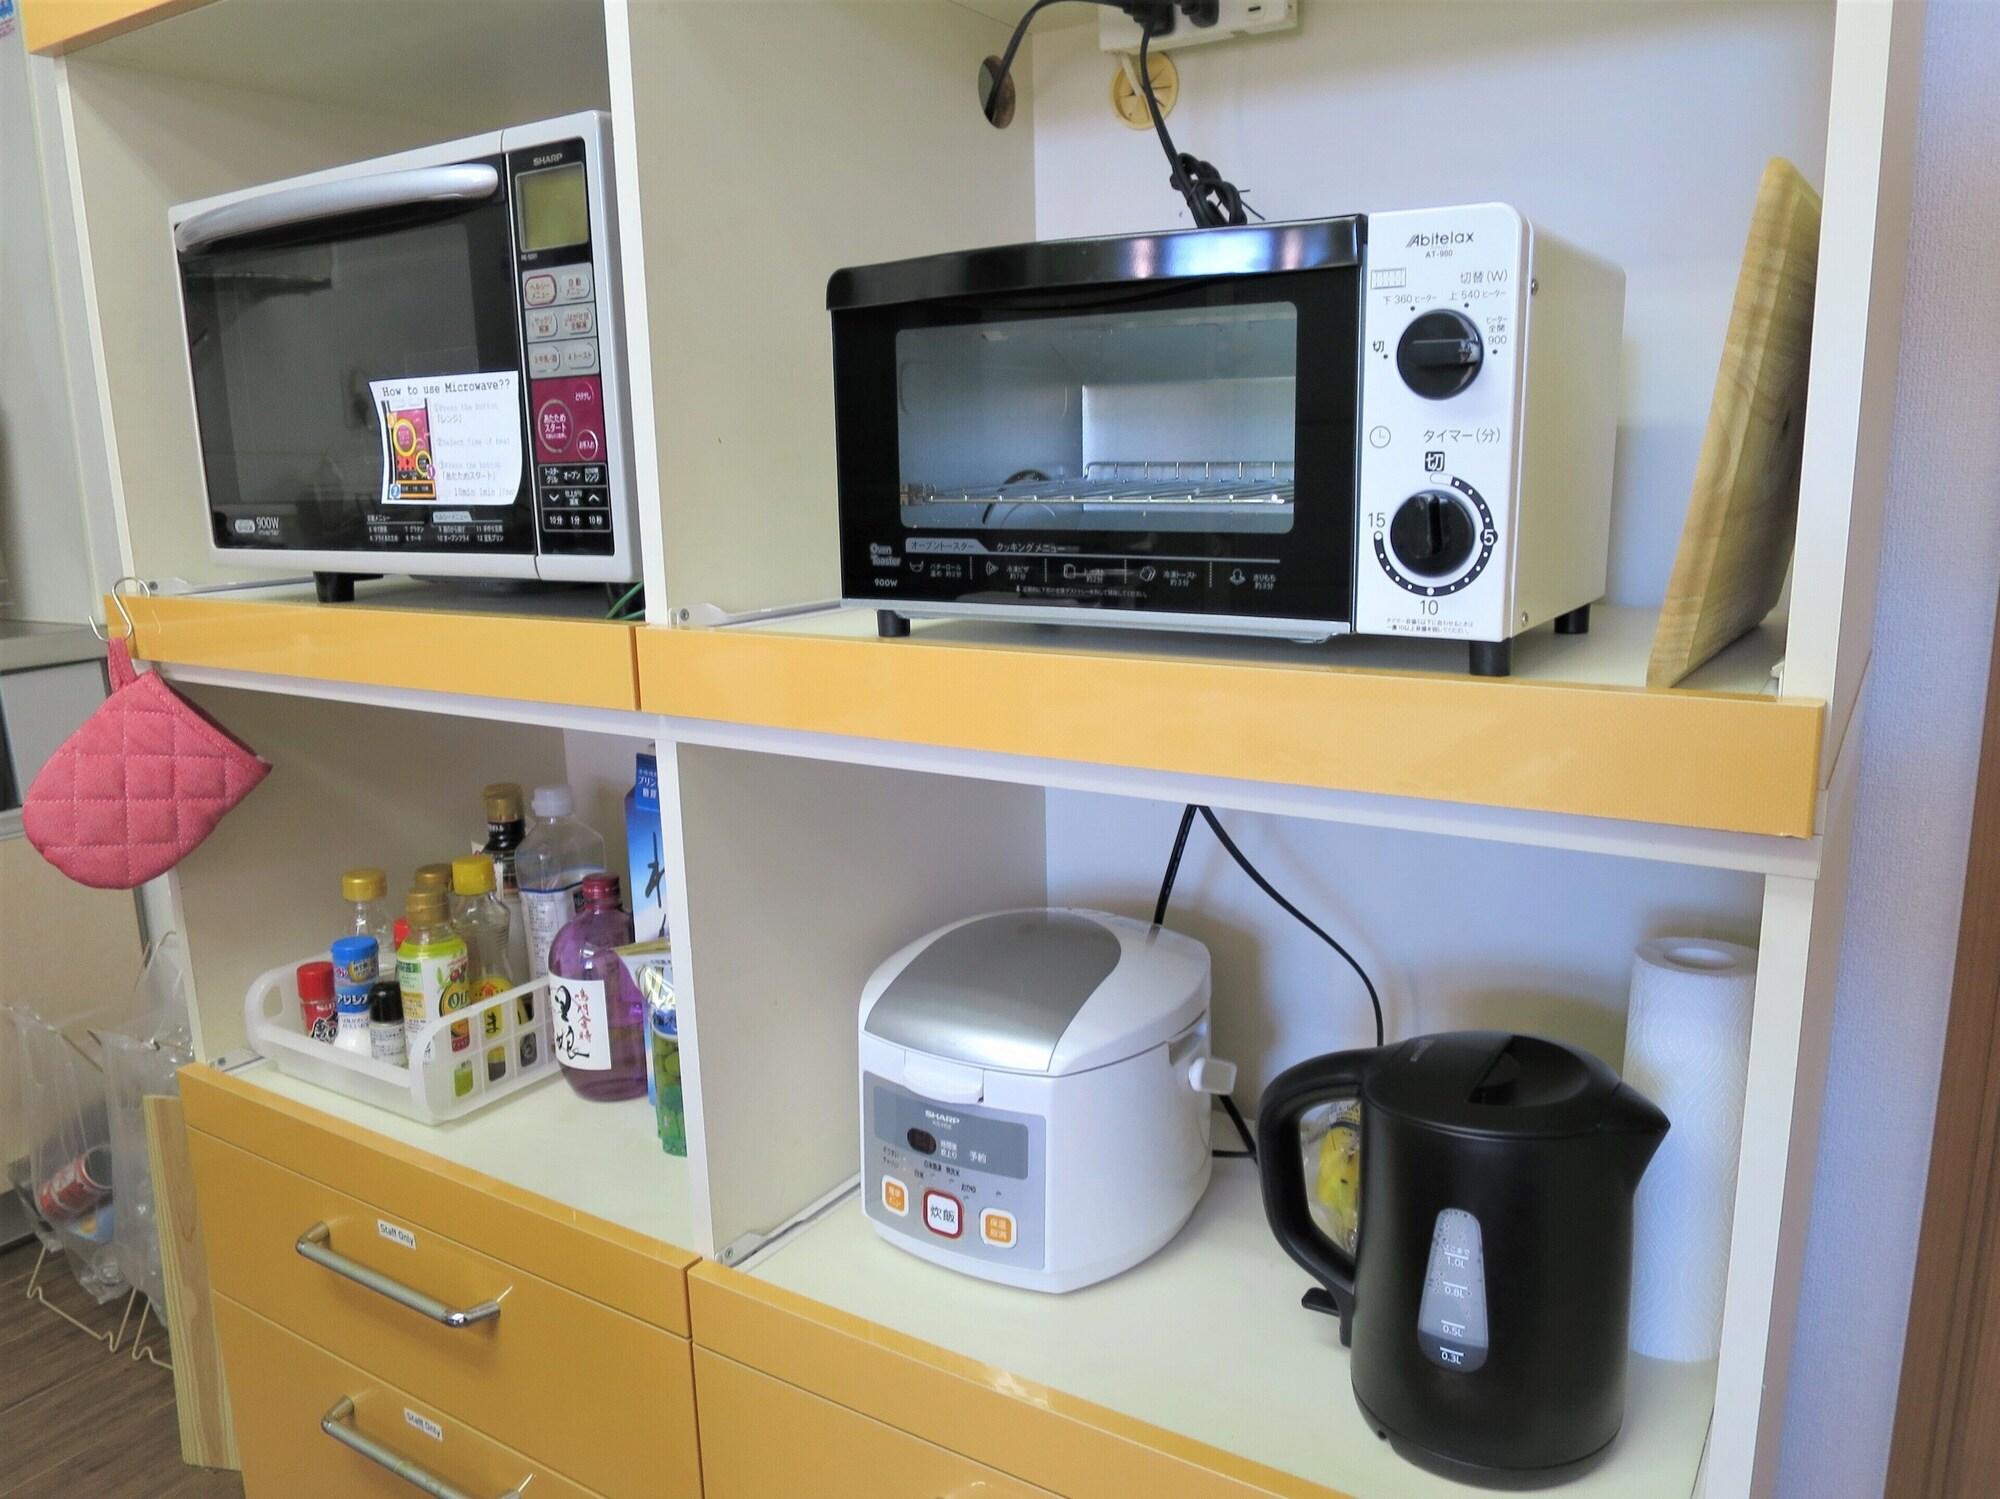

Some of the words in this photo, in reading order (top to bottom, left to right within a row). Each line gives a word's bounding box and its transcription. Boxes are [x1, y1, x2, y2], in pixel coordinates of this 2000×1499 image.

[533, 153, 563, 166] SHARP
[1406, 231, 1475, 248] Abitelax
[1394, 295, 1413, 304] 360
[1461, 290, 1480, 300] 540
[1372, 340, 1384, 352] 切
[1488, 334, 1507, 346] 900
[382, 386, 402, 398] How
[408, 385, 418, 396] to
[424, 386, 440, 395] use
[444, 380, 511, 393] Microwave??
[544, 414, 566, 424] あたため
[544, 423, 567, 433] スタート
[1426, 453, 1444, 471] 切
[564, 471, 581, 481] オーブン
[584, 473, 600, 483] レンジ
[256, 516, 280, 529] 900W
[549, 515, 563, 526] 10分
[570, 516, 580, 526] 1分
[1368, 512, 1386, 528] 15
[1483, 530, 1494, 546] 5
[870, 554, 901, 567] Toaster
[874, 578, 898, 588] 900W
[1419, 600, 1438, 616] 10
[924, 1110, 960, 1124] SHARP
[969, 1150, 986, 1164] 予約
[930, 1205, 955, 1224] 炊飯
[380, 1223, 397, 1238] Staff
[398, 1232, 415, 1247] Only
[1447, 1258, 1464, 1269] 1.0L
[1444, 1286, 1464, 1298] 0.8L
[1442, 1324, 1462, 1338] 0.5L
[1442, 1351, 1462, 1365] 0.3L
[406, 1411, 424, 1429] Staff
[424, 1418, 441, 1438] Only
